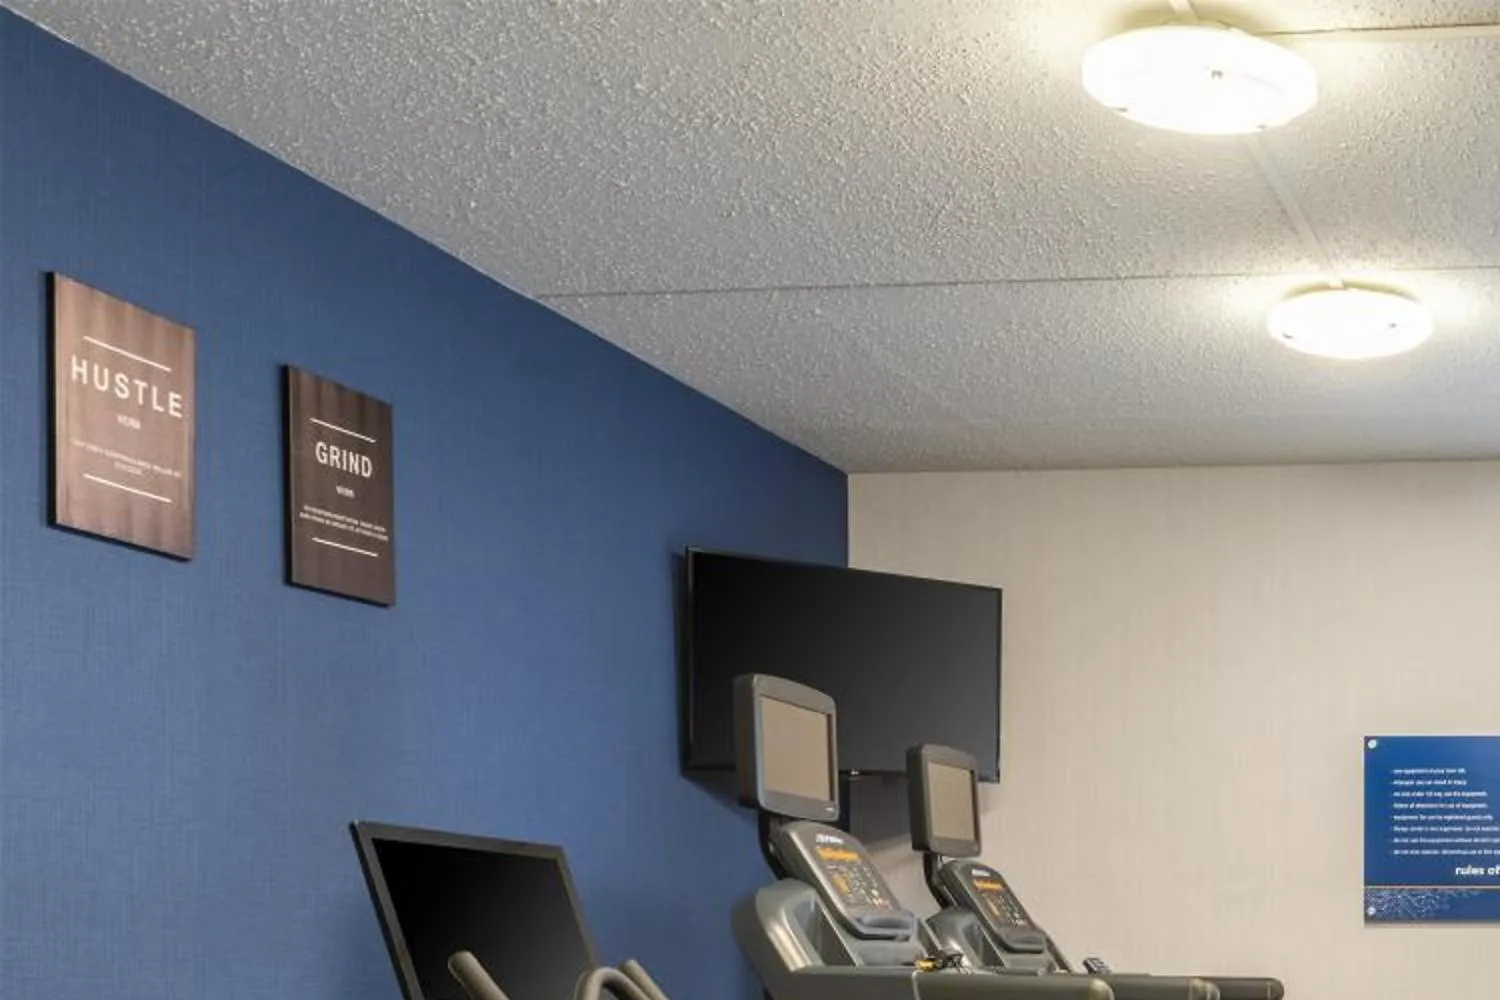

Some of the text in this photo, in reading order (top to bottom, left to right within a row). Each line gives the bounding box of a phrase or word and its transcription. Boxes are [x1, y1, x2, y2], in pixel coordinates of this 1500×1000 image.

[71, 354, 183, 418] HUSTLE
[315, 441, 373, 478] GRIND
[1455, 864, 1485, 876] rules
[1487, 864, 1500, 875] of
